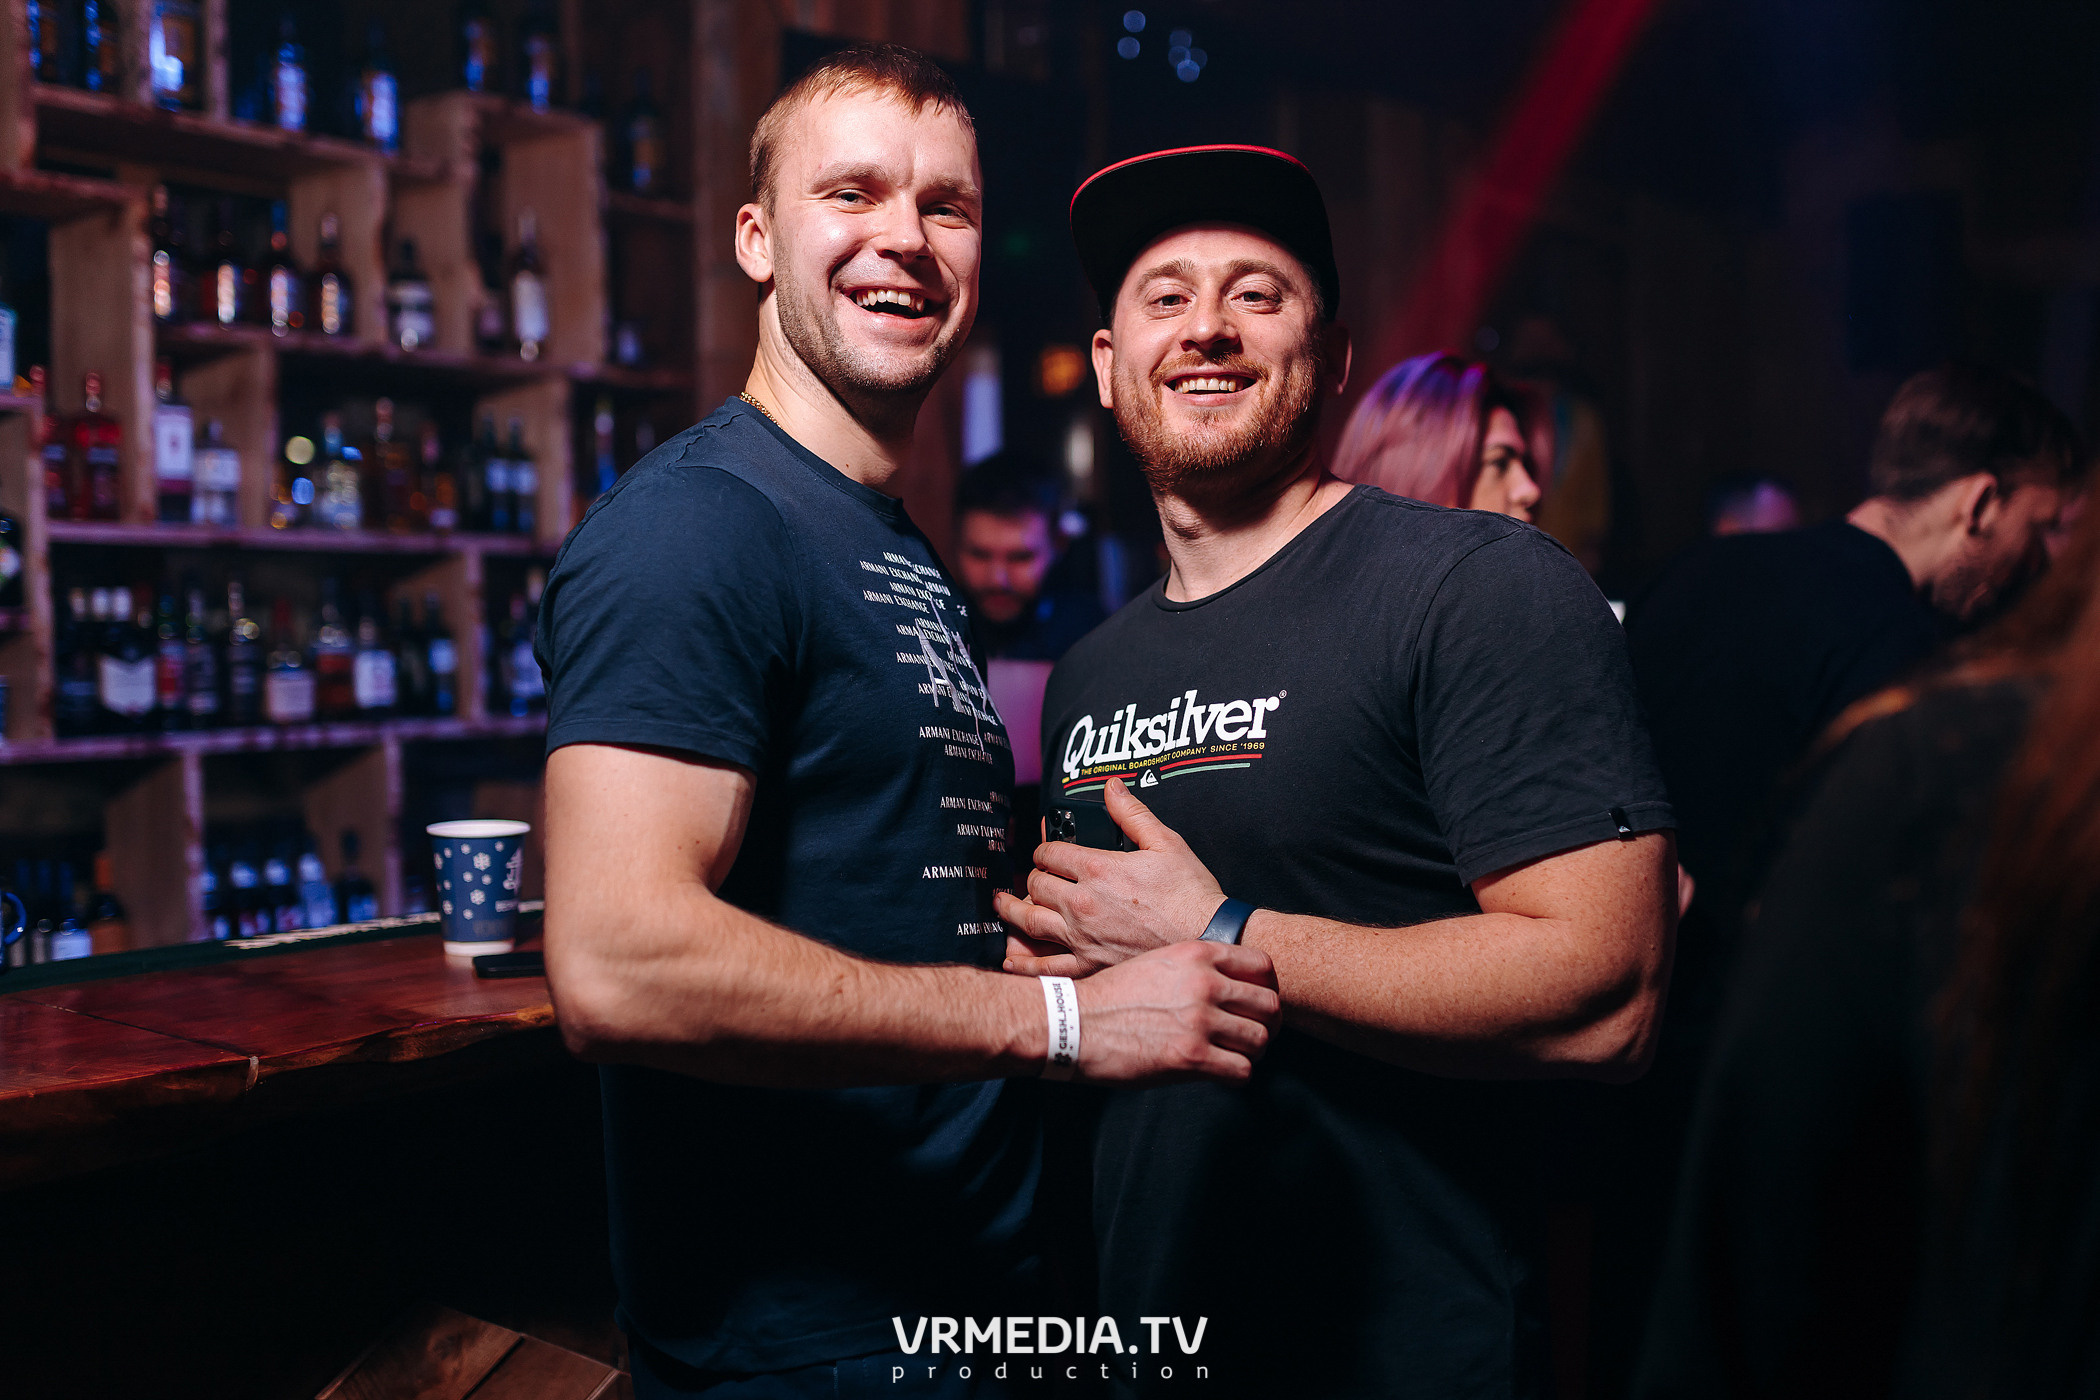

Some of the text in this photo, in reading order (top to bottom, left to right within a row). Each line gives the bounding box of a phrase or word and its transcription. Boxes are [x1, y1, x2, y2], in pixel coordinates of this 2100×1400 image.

[863, 589, 894, 605] ARMANI
[896, 624, 919, 637] ARMA
[919, 726, 980, 746] ARMANI EXCHANGE
[1062, 689, 1280, 779] Quiksilver
[944, 744, 968, 759] ARMANI
[1081, 768, 1093, 776] THE
[1093, 762, 1127, 774] ORIGINAL
[1129, 753, 1170, 770] BOARDSHORT
[1171, 746, 1207, 760] COMPANY
[1210, 743, 1238, 753] SINCE
[940, 796, 966, 809] ARMANI
[922, 866, 963, 879] ARMANI
[957, 923, 982, 936] ARMA
